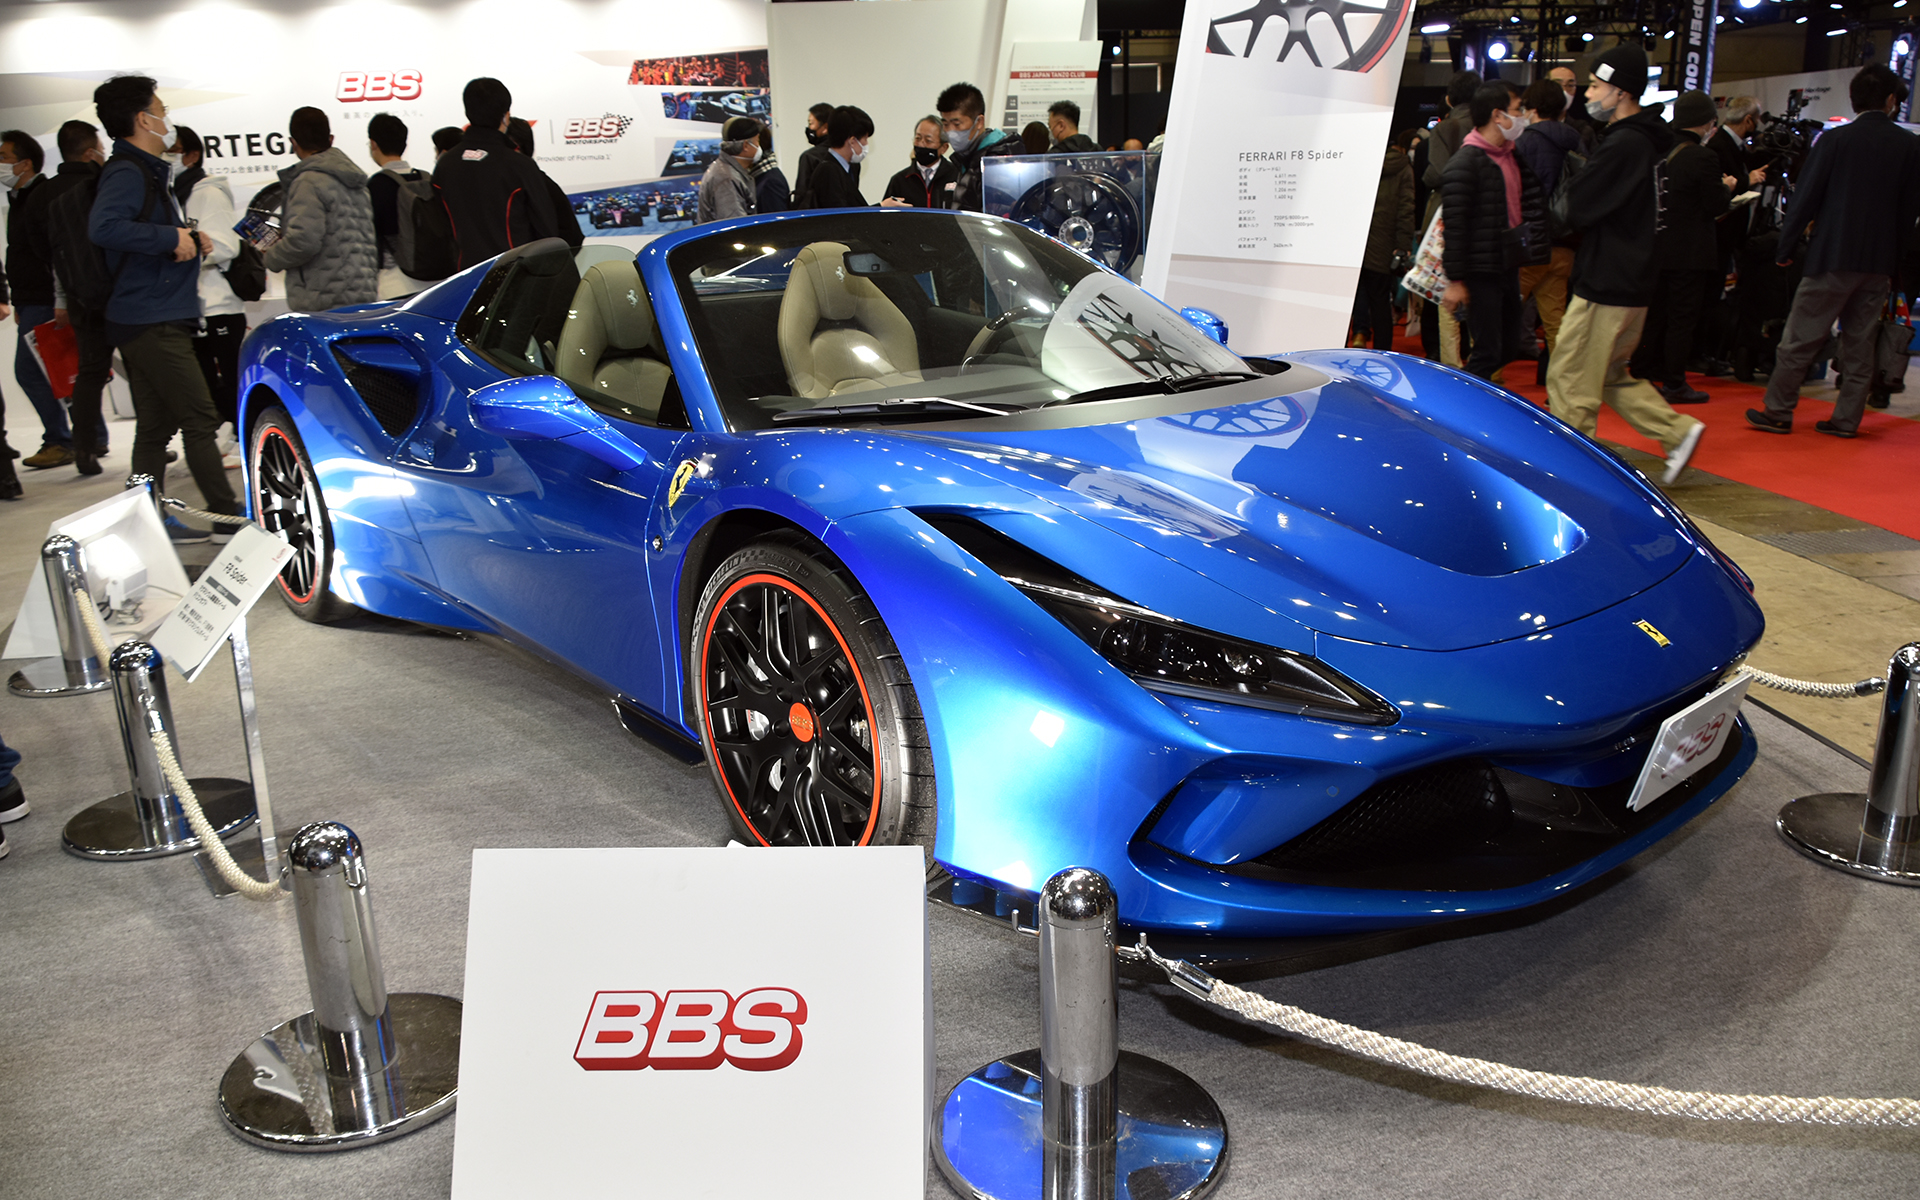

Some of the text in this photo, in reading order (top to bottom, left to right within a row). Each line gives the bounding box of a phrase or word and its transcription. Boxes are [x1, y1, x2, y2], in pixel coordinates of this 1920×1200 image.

[335, 68, 423, 103] BBS
[1683, 51, 1700, 93] COU
[564, 117, 621, 139] BBS
[203, 132, 296, 158] RTEG
[1239, 149, 1344, 162] FERRARI F8 Spider
[230, 567, 248, 585] Spider
[1661, 713, 1726, 779] BBS
[573, 986, 808, 1071] BBS
